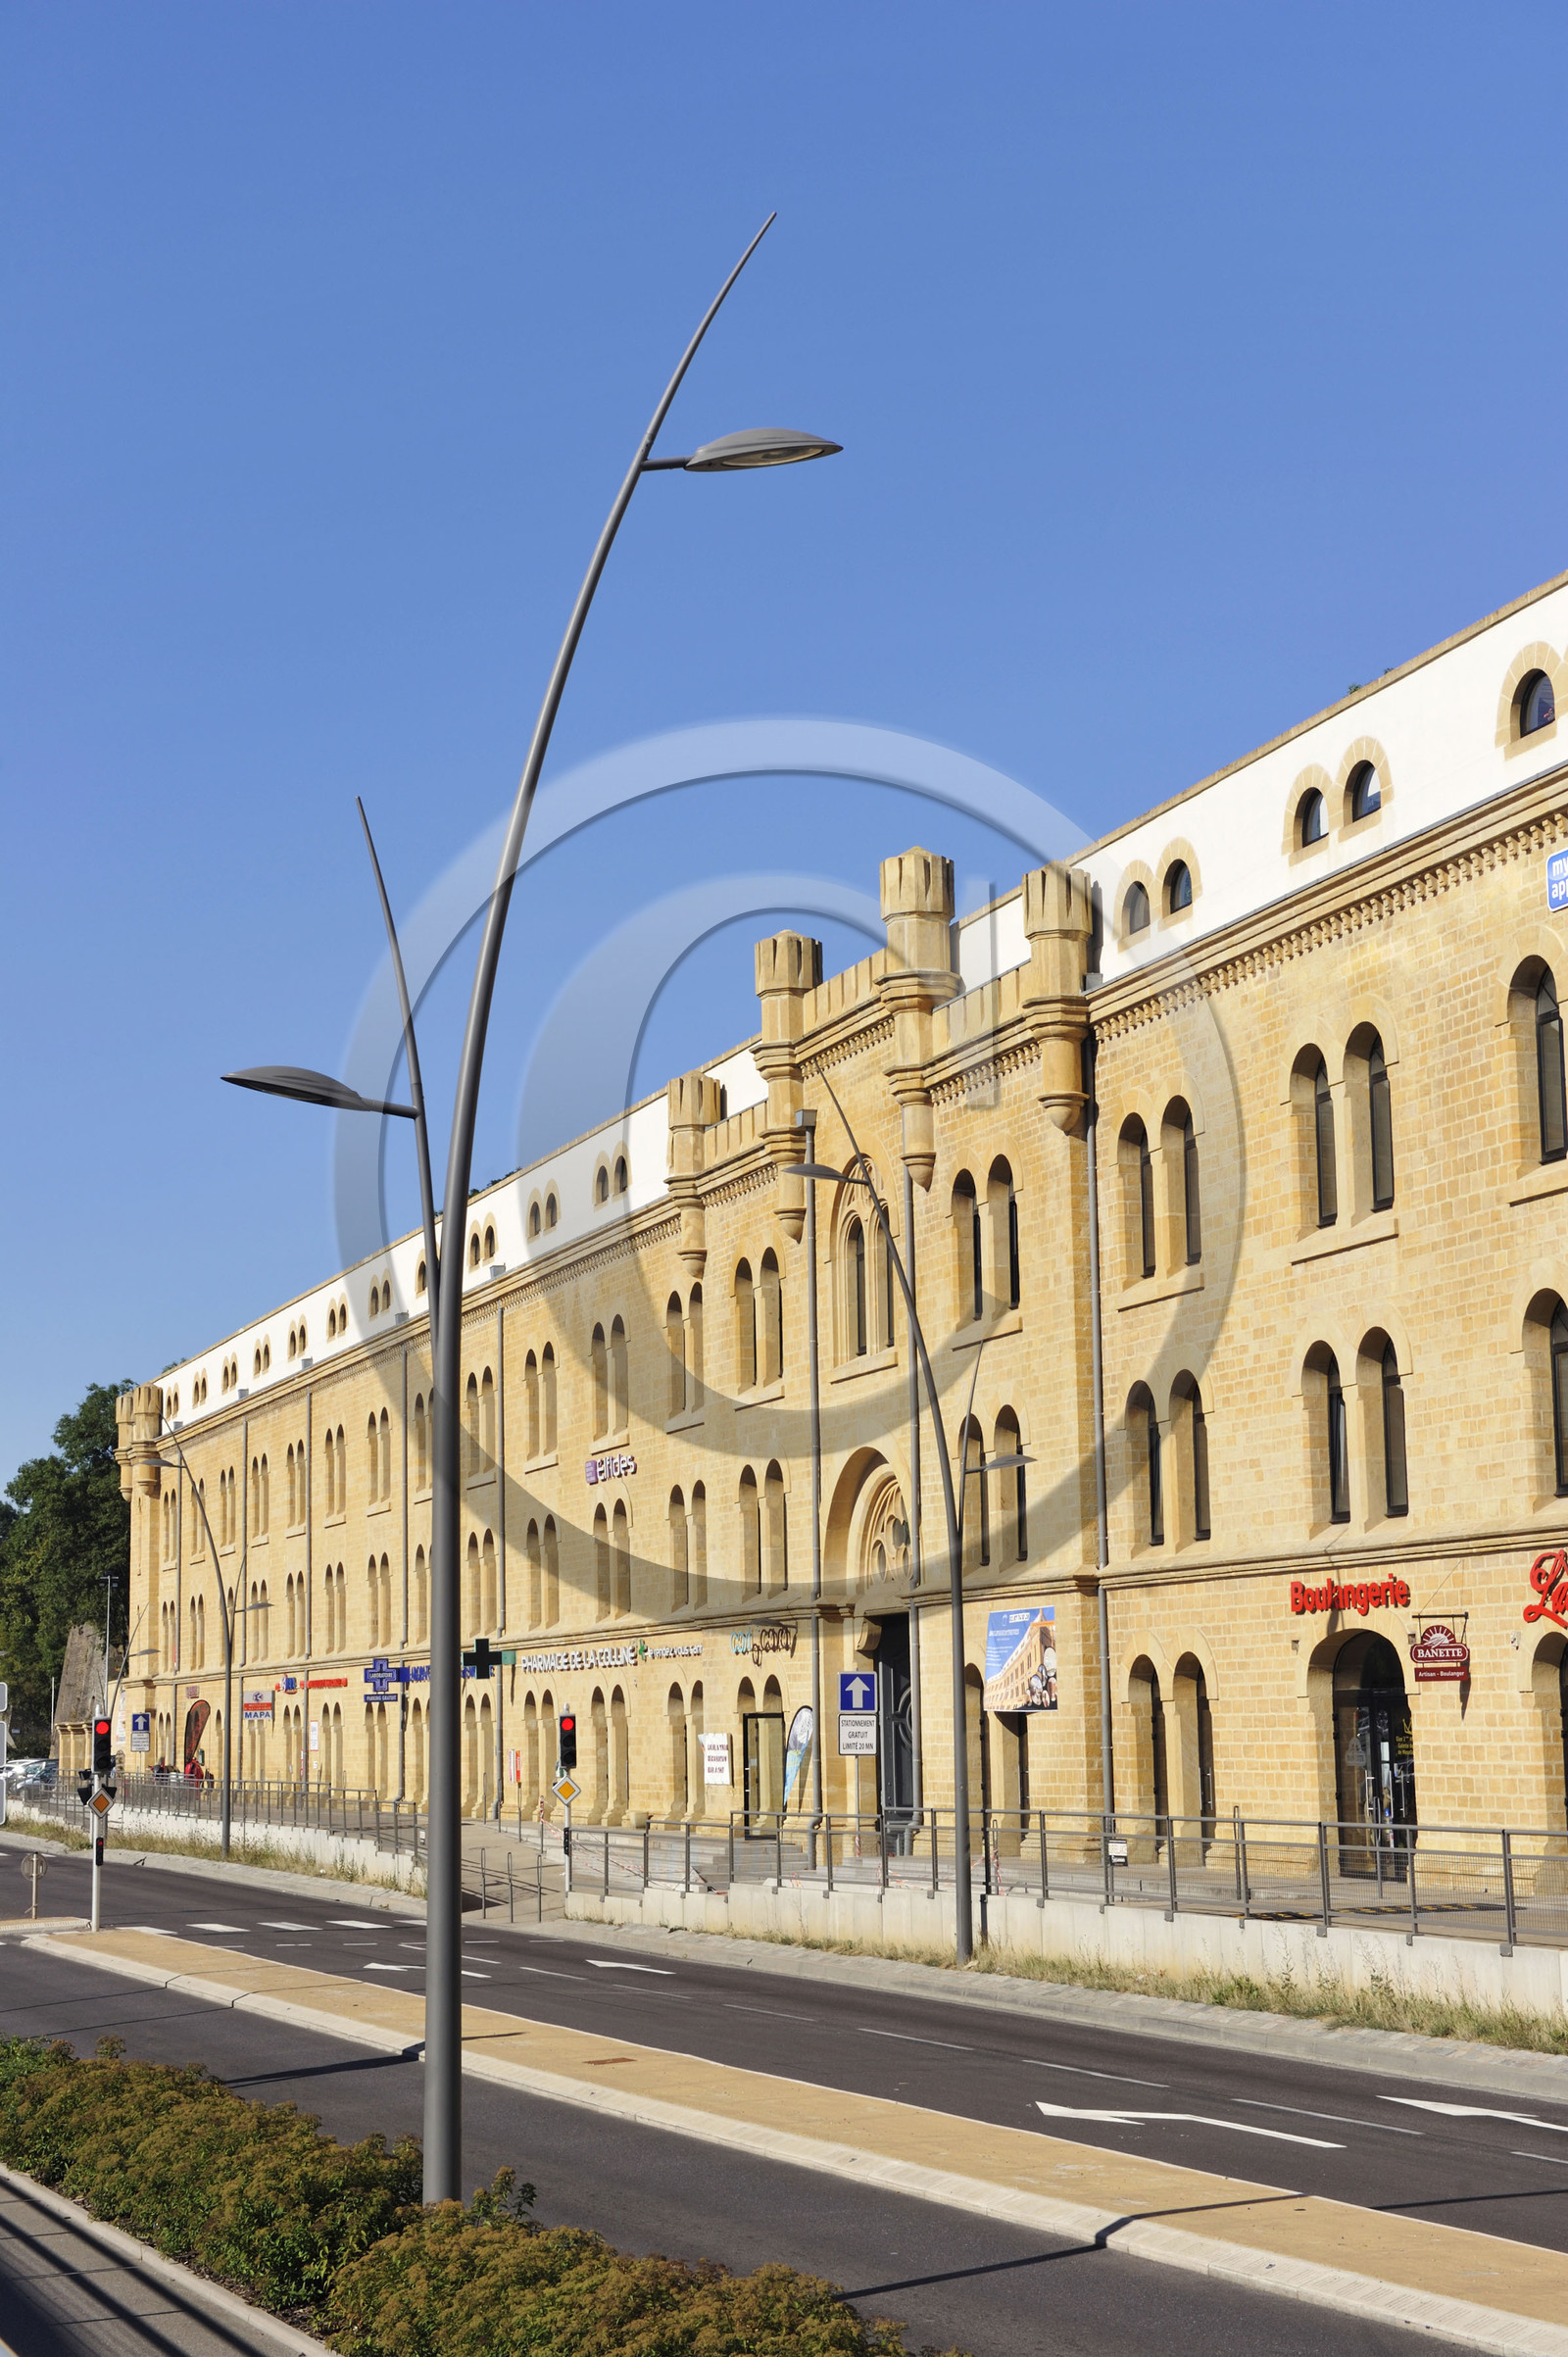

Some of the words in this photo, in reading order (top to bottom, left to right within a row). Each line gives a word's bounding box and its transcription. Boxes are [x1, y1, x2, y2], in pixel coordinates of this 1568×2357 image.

[1551, 878, 1568, 901] ap
[1290, 1573, 1409, 1617] Boulangerie
[521, 1651, 568, 1672] PHARMACIE
[570, 1650, 584, 1669] DE
[584, 1649, 597, 1668] LA
[598, 1645, 637, 1667] COLLINE
[1417, 1647, 1463, 1658] BANETTE
[843, 1742, 858, 1750] LIMITÉ
